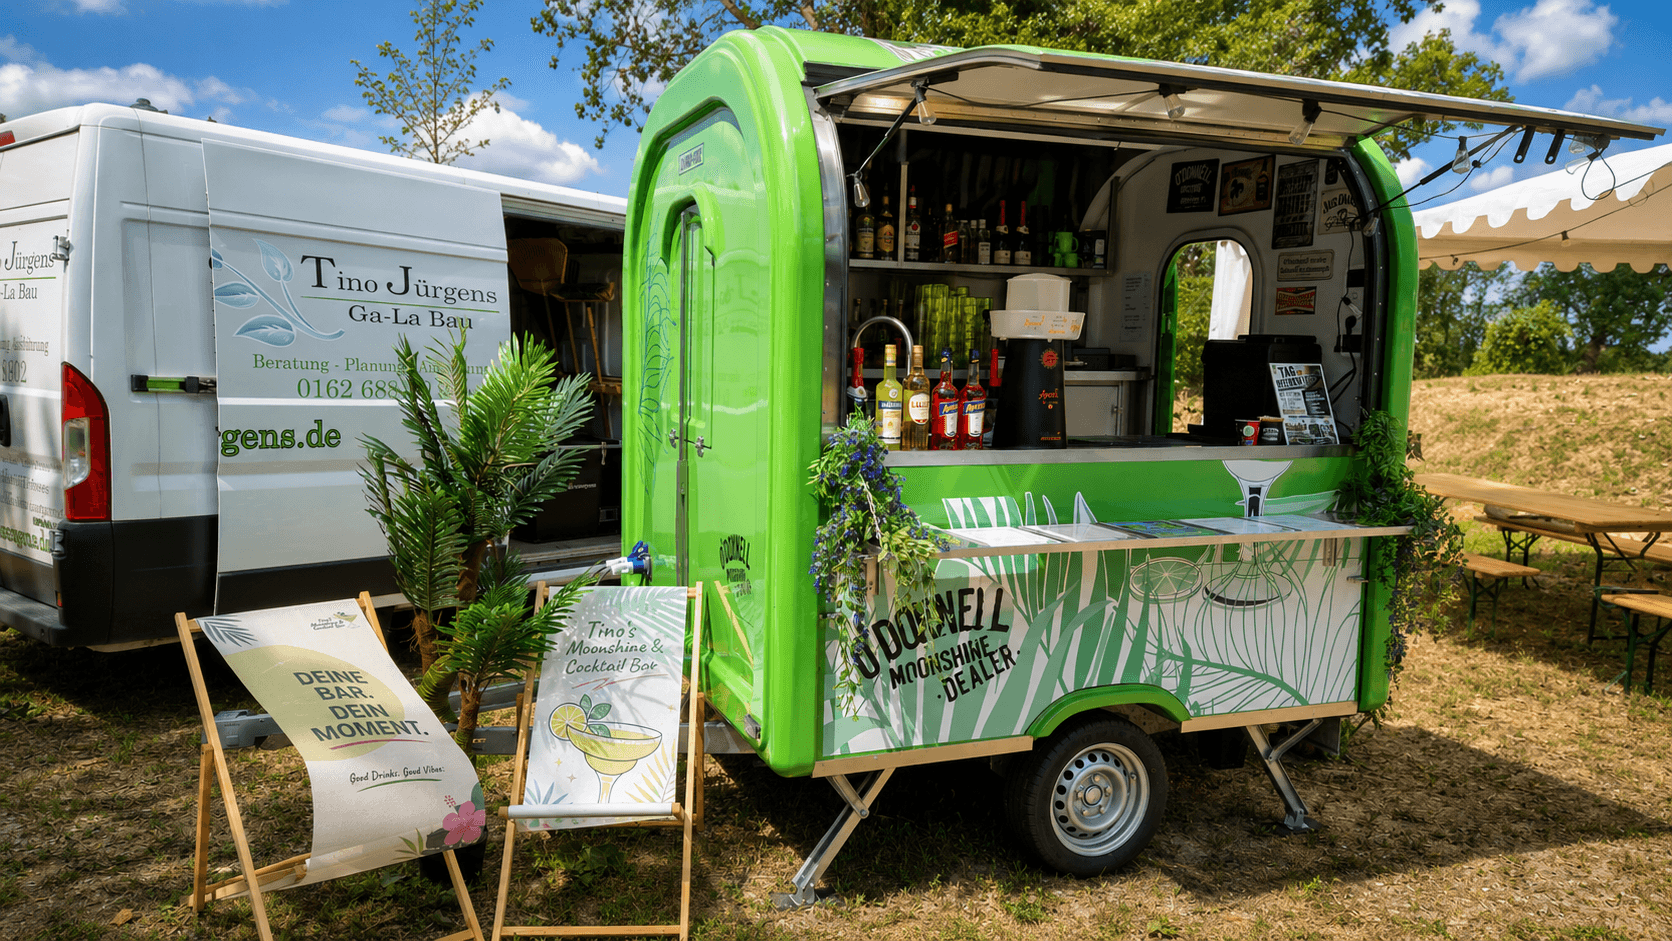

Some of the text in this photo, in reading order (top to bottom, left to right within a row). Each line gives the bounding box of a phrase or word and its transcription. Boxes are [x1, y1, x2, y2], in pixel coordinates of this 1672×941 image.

[4, 240, 55, 275] Jürgens
[300, 254, 498, 304] Tino Jürgens
[18, 282, 38, 300] Bau
[348, 305, 473, 329] Ga-La Bau
[252, 353, 330, 373] Beratung
[1277, 365, 1297, 379] TAG
[297, 377, 353, 399] 0162
[587, 620, 637, 639] Tino's
[565, 638, 664, 656] Moonshine &
[565, 657, 659, 675] Cocktail Bar
[888, 635, 991, 690] MOONSHINE
[293, 670, 368, 686] DEINE
[314, 686, 374, 701] BAR.
[328, 704, 389, 720] DEIN
[310, 720, 429, 742] MOMENT.
[349, 772, 369, 786] Good
[371, 769, 400, 781] Drinks.
